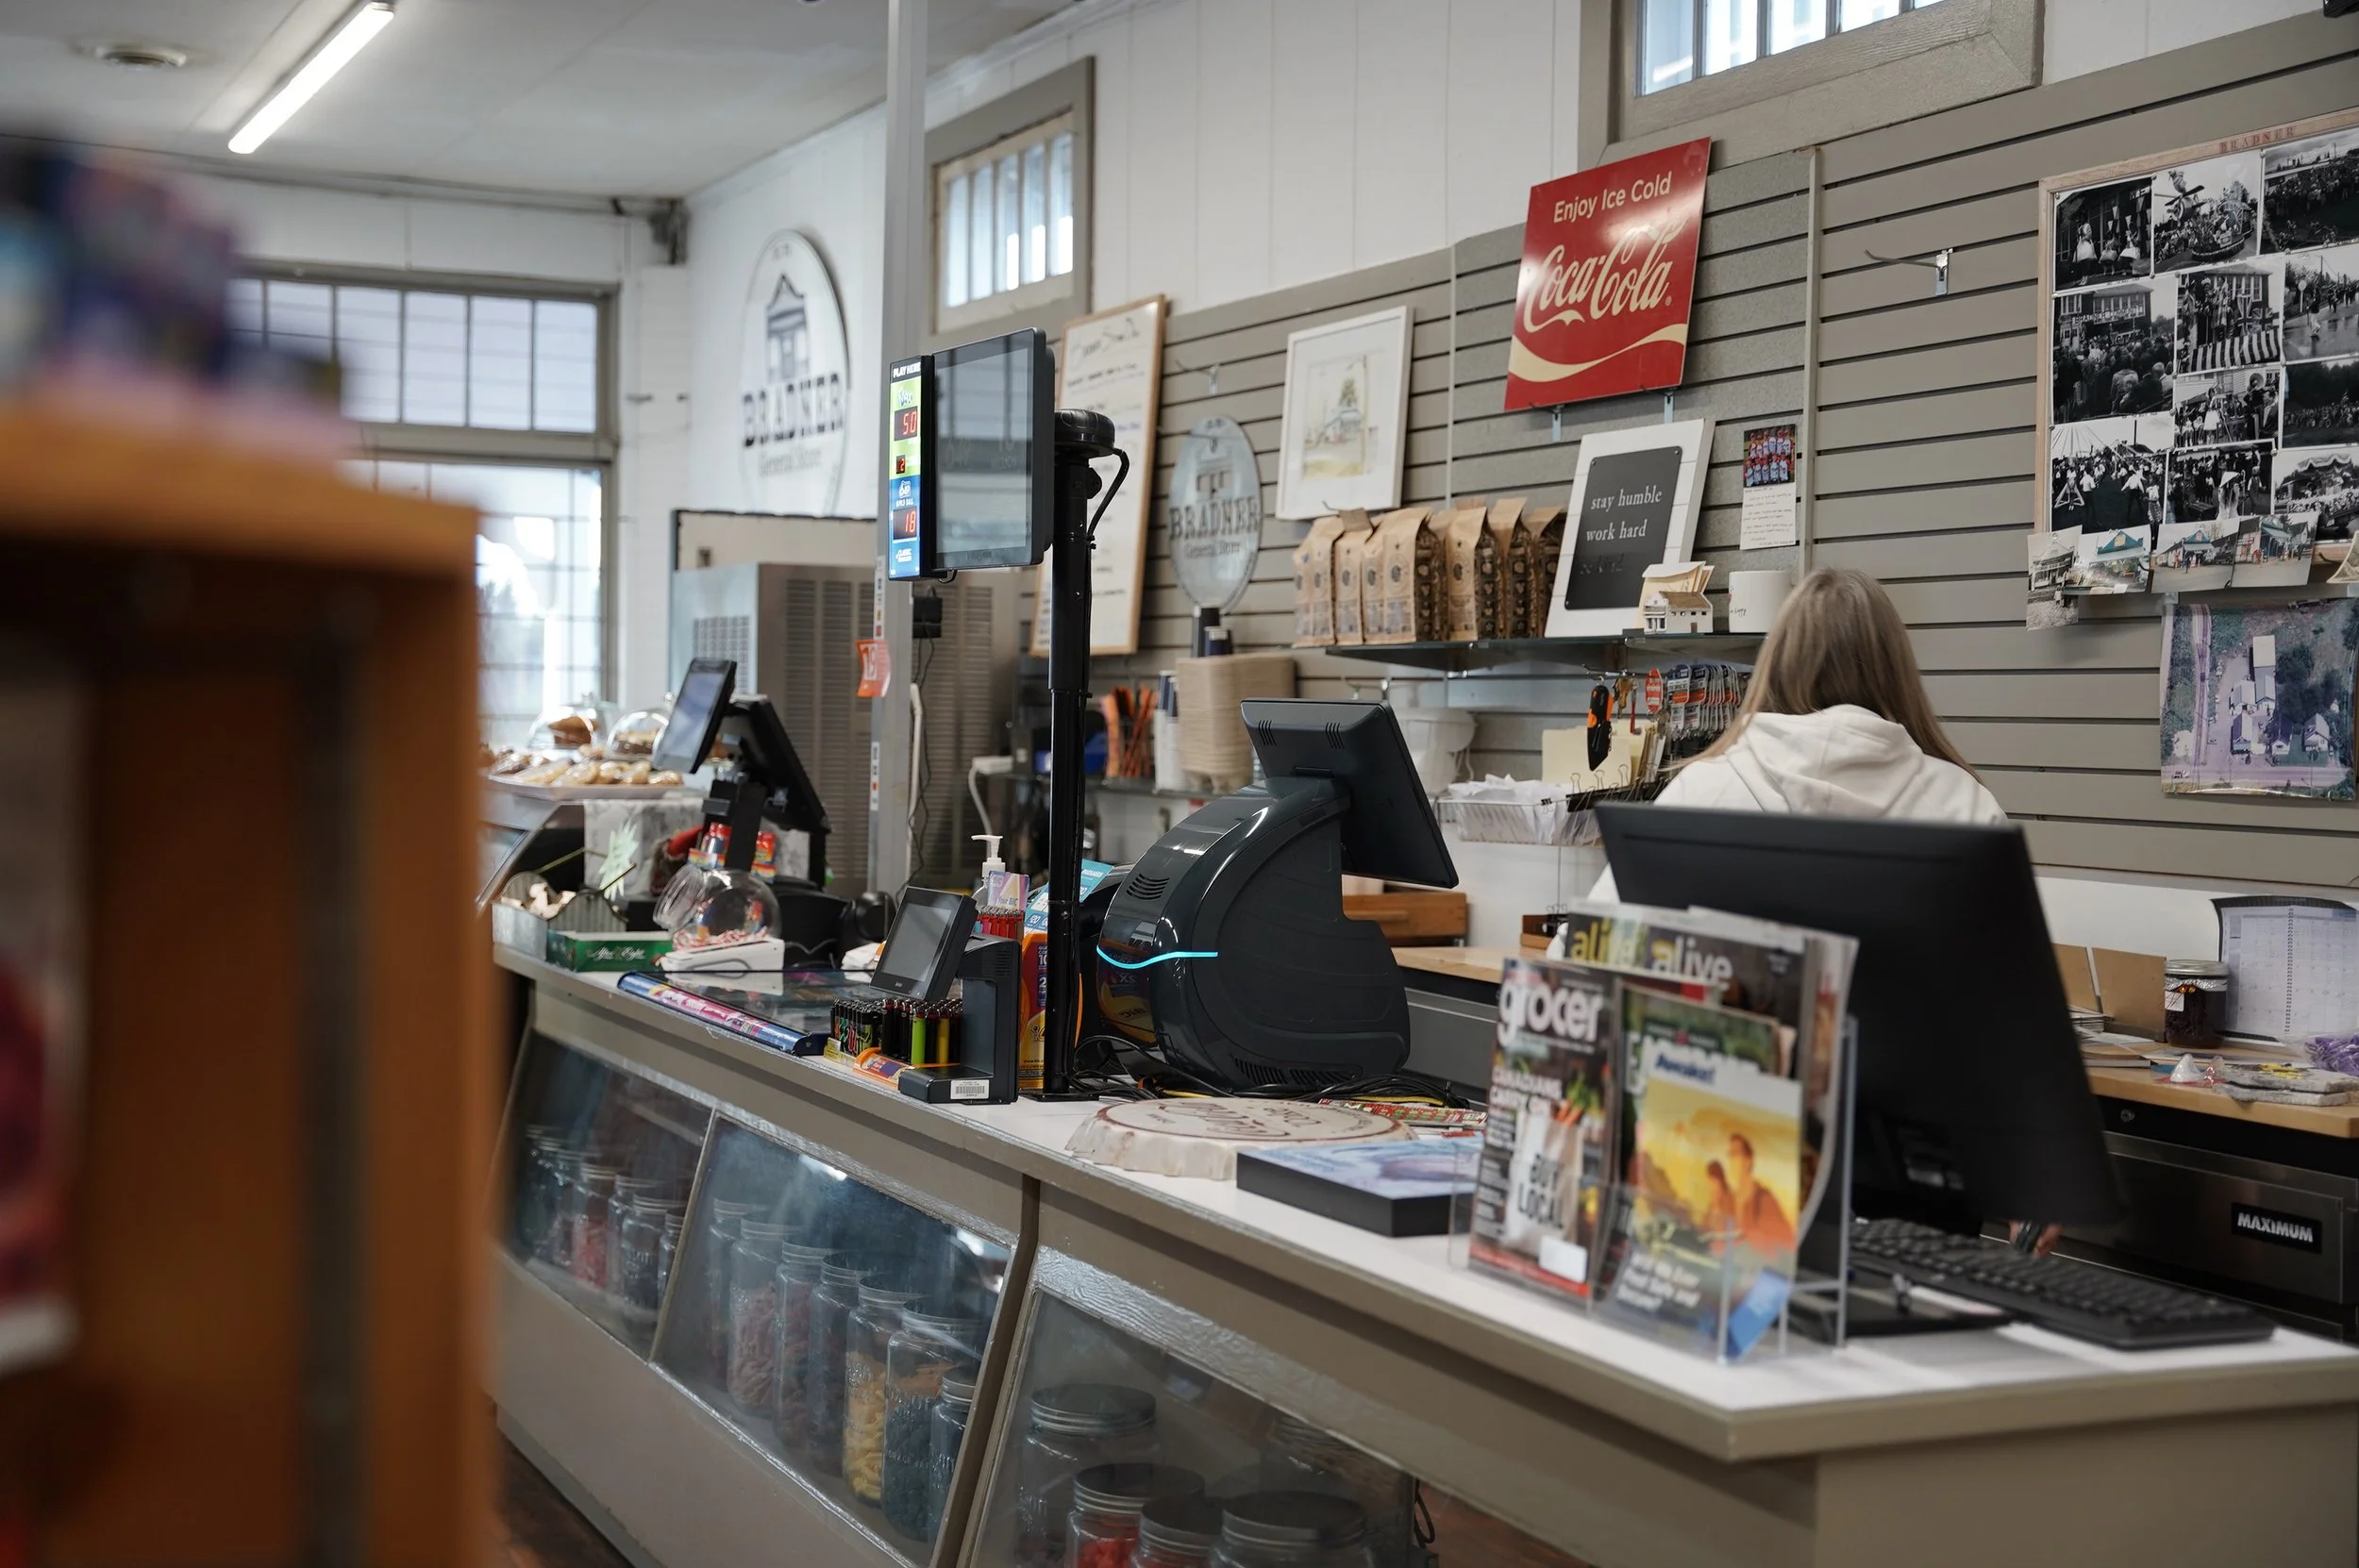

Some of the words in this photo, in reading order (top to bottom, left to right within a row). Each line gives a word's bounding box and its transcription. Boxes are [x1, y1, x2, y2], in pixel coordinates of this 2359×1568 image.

[2218, 125, 2296, 153] BRADNER
[1553, 196, 1598, 224] Enjoy
[1601, 188, 1626, 211] Ice
[1631, 171, 1673, 203] Cold
[1523, 216, 1690, 333] Coca-Cola
[893, 365, 907, 378] PLAY
[743, 374, 844, 448] BRADNER
[902, 411, 916, 436] 50
[1590, 495, 1615, 512] stay
[1617, 484, 1664, 508] humble
[905, 510, 916, 533] 18
[1169, 496, 1259, 542] BRADNER
[1586, 525, 1615, 542] work
[1618, 519, 1648, 541] hard
[1652, 936, 1734, 992] alive
[1497, 977, 1605, 1049] grocer
[1518, 1182, 1564, 1229] LOCAL
[2237, 1212, 2314, 1243] MAXIMUM
